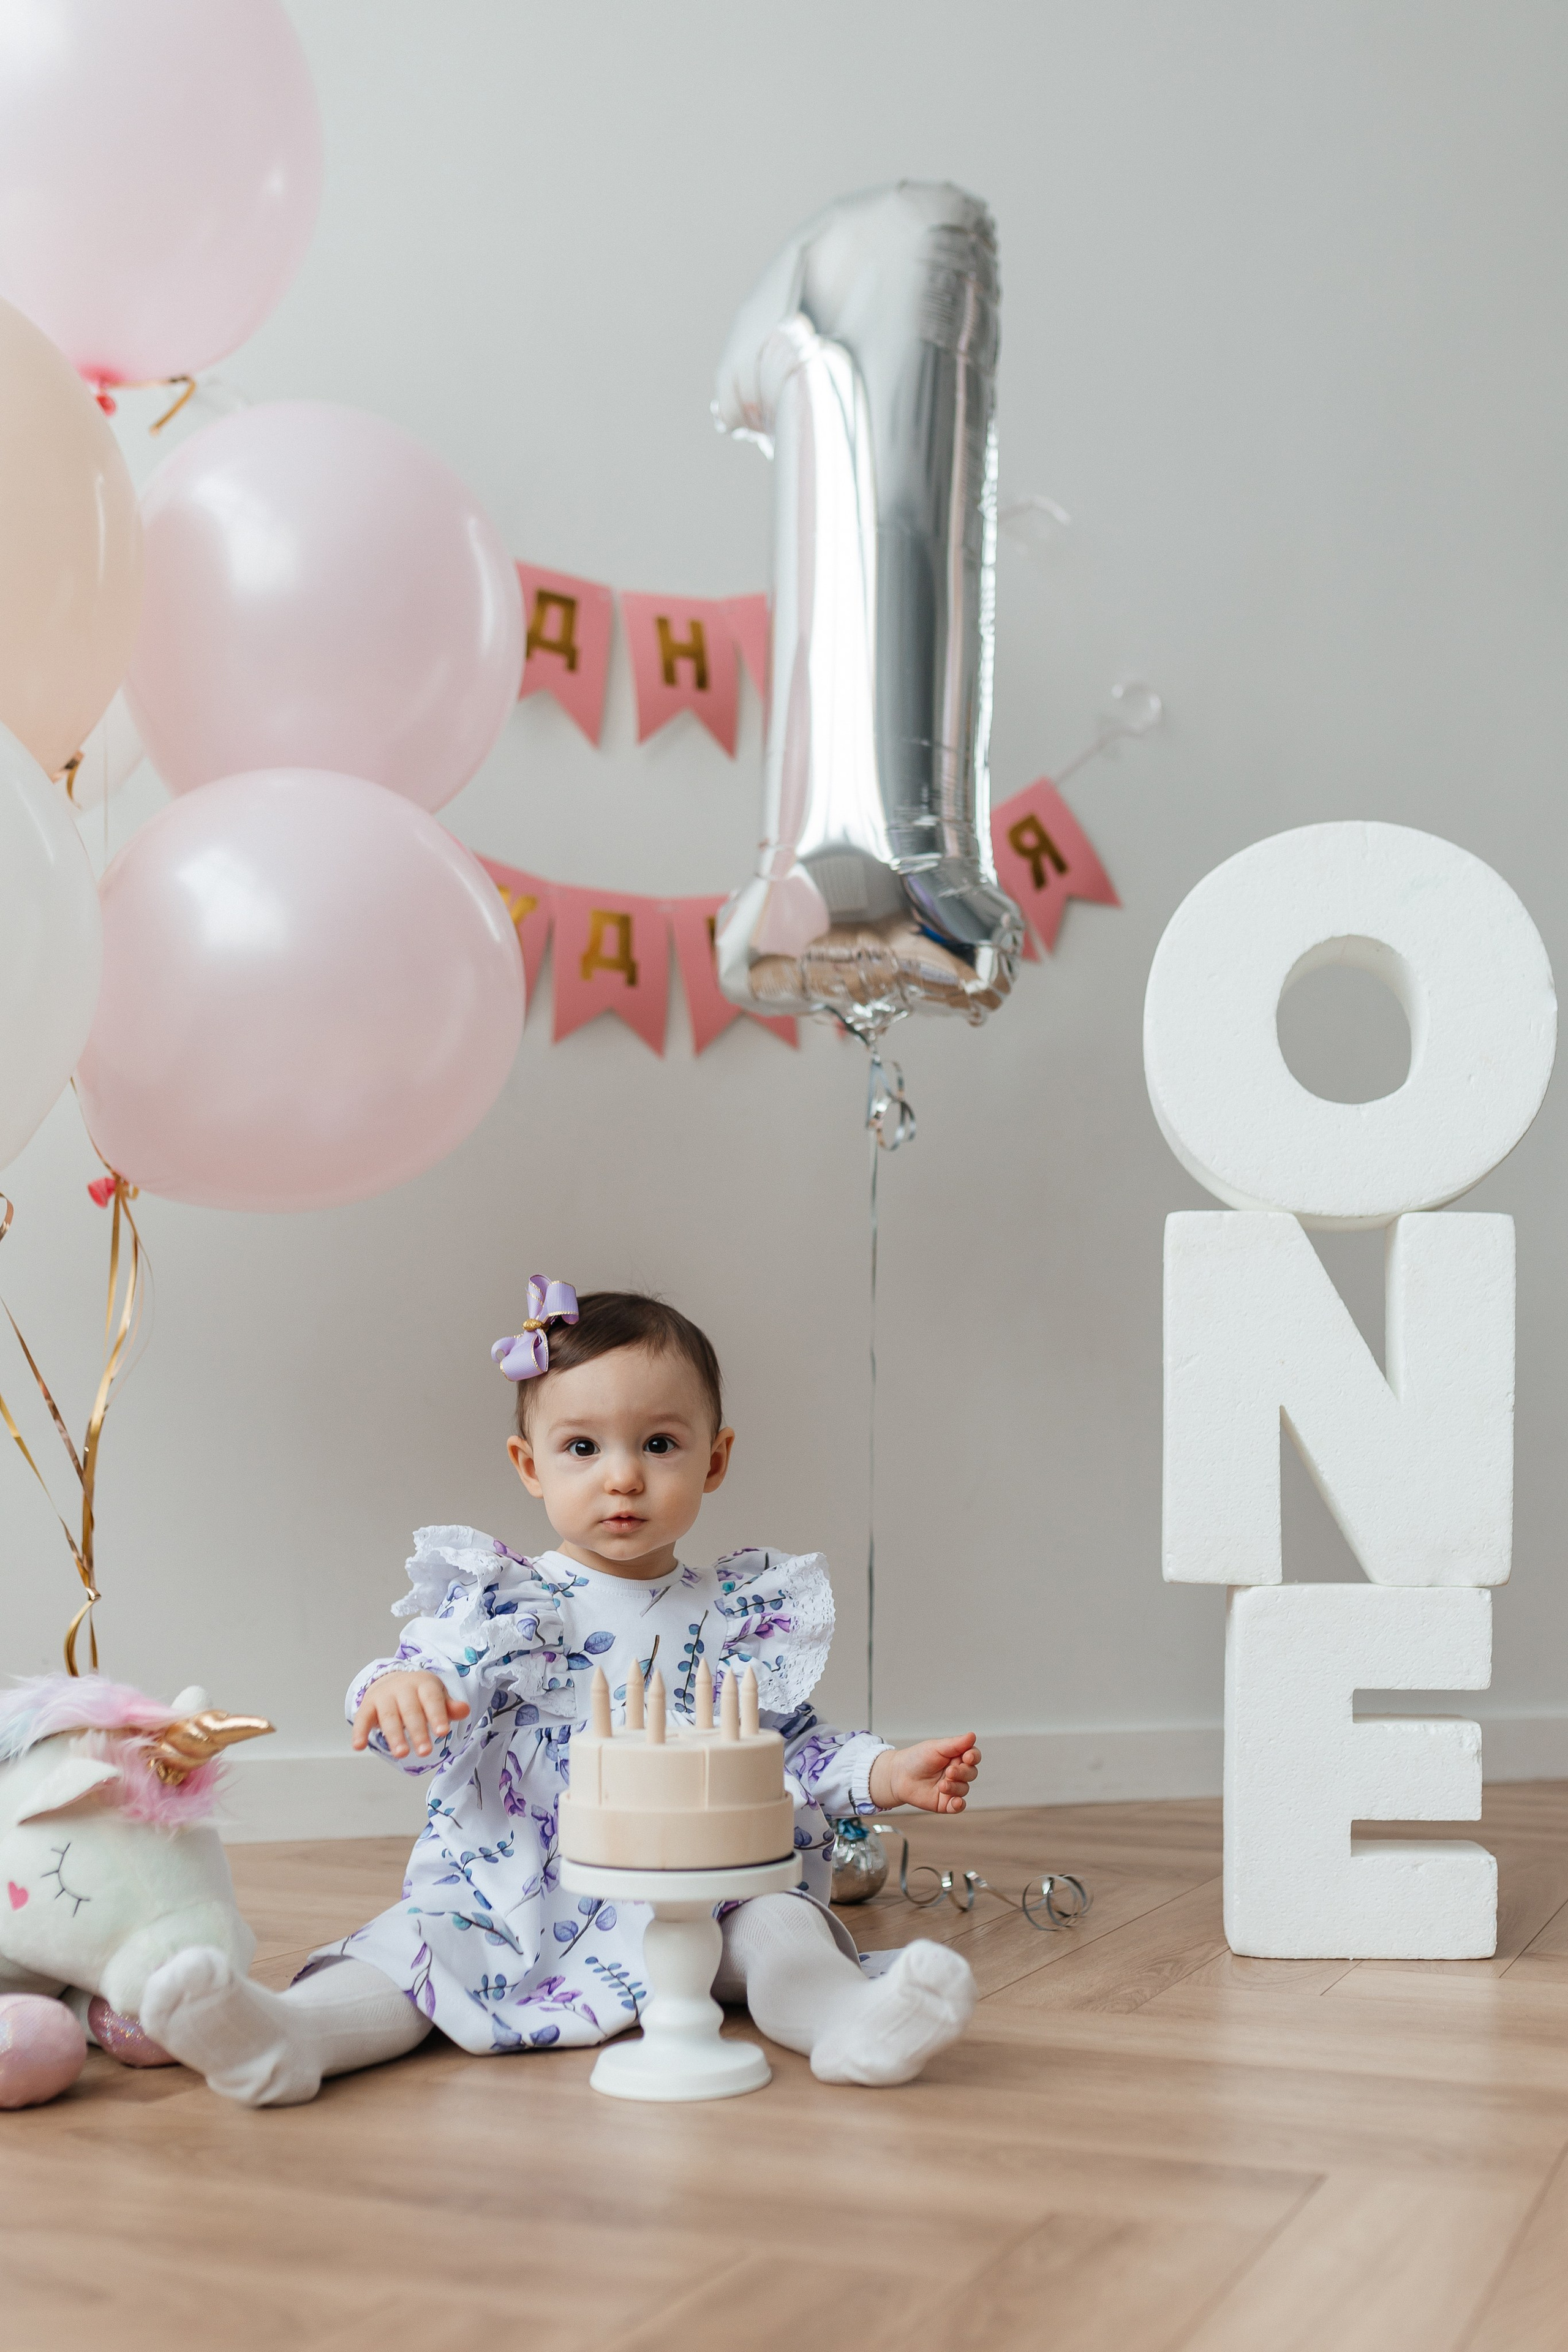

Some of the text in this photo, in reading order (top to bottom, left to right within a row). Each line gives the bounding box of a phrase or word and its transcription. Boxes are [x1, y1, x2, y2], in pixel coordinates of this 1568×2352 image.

[526, 589, 708, 691] ДН
[710, 179, 1020, 1026] 1
[1144, 821, 1557, 1960] ONE
